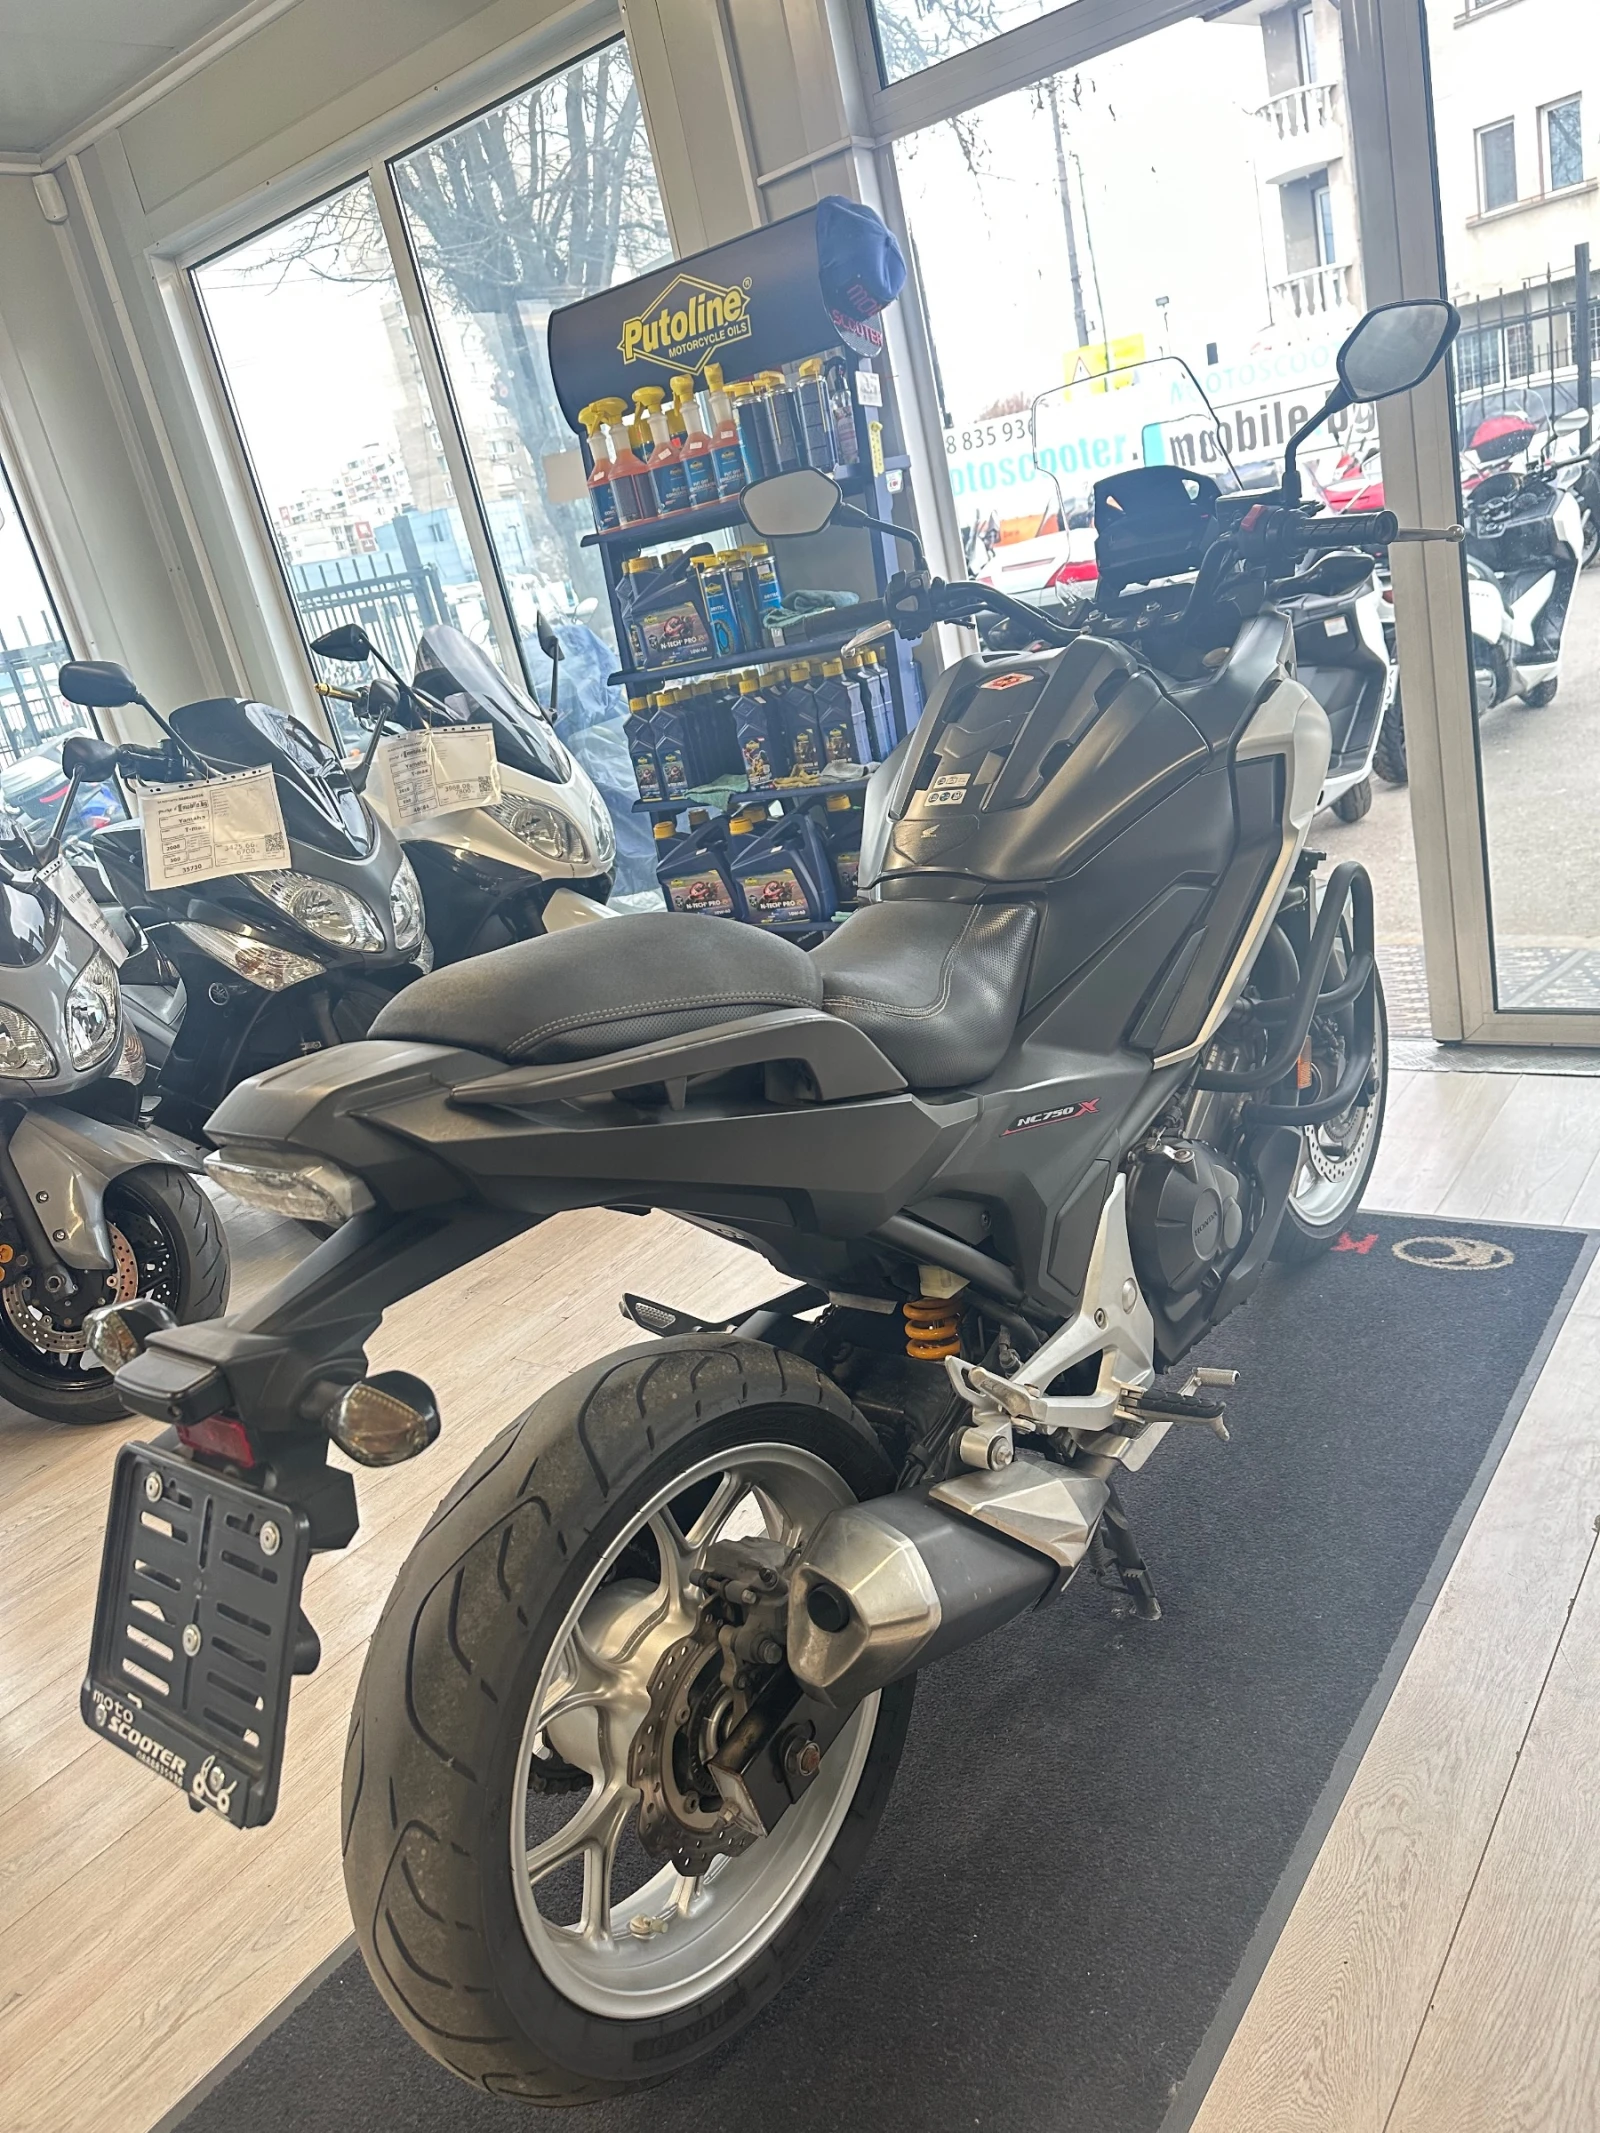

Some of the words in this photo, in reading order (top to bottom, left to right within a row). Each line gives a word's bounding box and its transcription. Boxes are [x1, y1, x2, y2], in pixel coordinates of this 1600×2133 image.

[624, 290, 742, 360] Putoline
[668, 330, 725, 358] MOTORCYCLE
[727, 322, 748, 337] OILS
[962, 425, 996, 450] 835
[1193, 1210, 1218, 1237] HONDA
[93, 1689, 134, 1724] moto
[107, 1715, 187, 1775] SCOOTER
